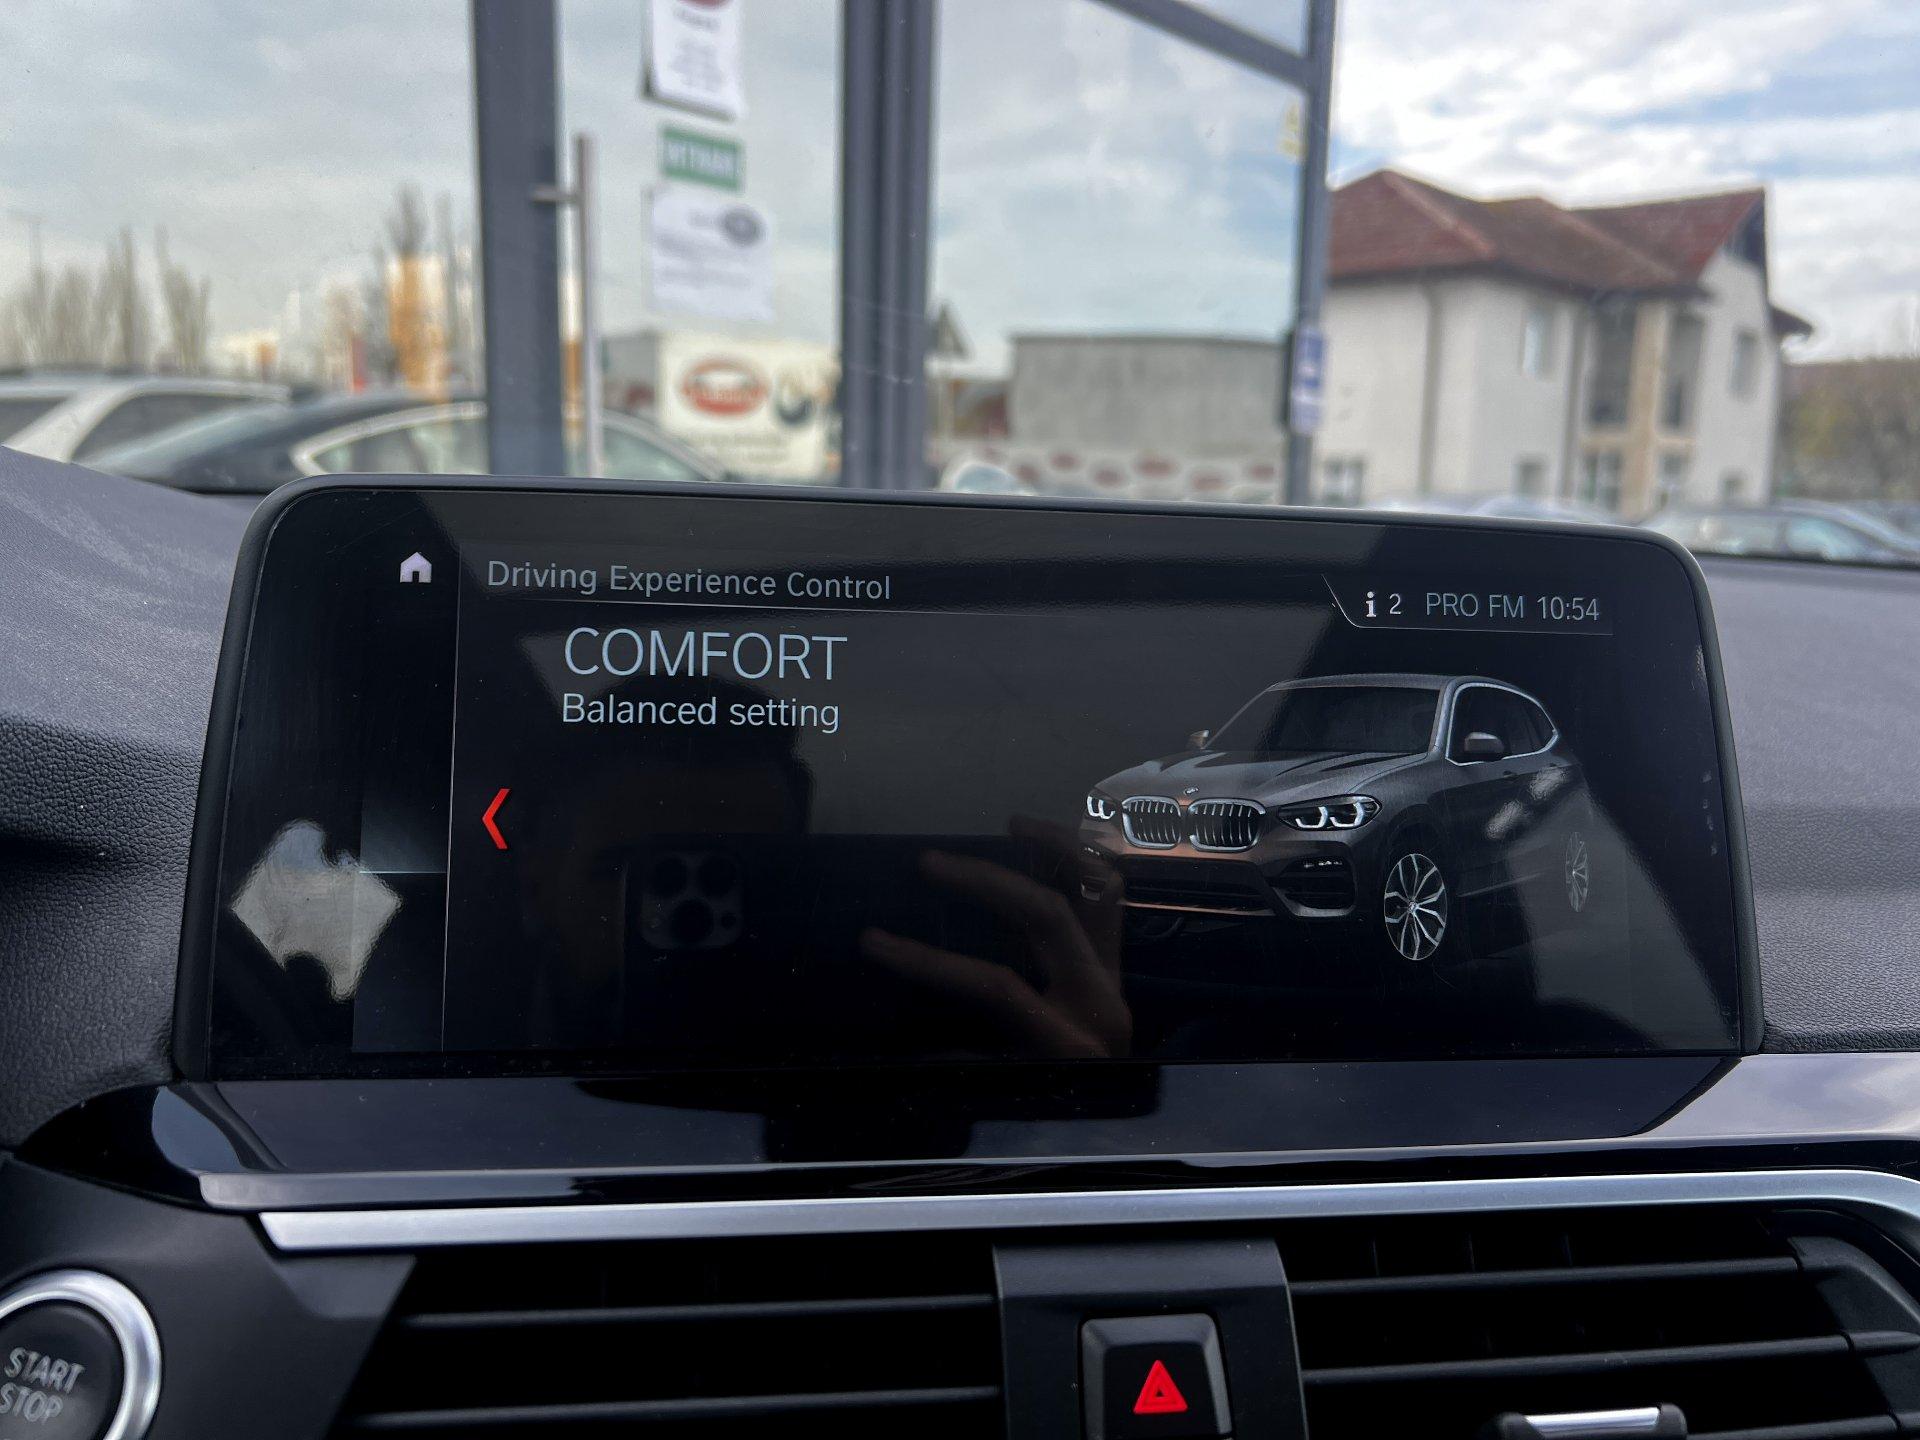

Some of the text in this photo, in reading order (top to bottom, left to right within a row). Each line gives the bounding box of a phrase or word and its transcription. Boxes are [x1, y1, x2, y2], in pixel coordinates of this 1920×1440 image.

[488, 560, 891, 600] Driving Experience Control
[1389, 593, 1402, 615] 2
[1426, 592, 1479, 617] PRO
[1489, 594, 1525, 619] FM
[1537, 596, 1601, 621] 10:54
[564, 627, 848, 681] COMFORT
[562, 692, 840, 734] Balanced setting
[4, 1347, 86, 1394] START
[0, 1382, 64, 1424] STOP
